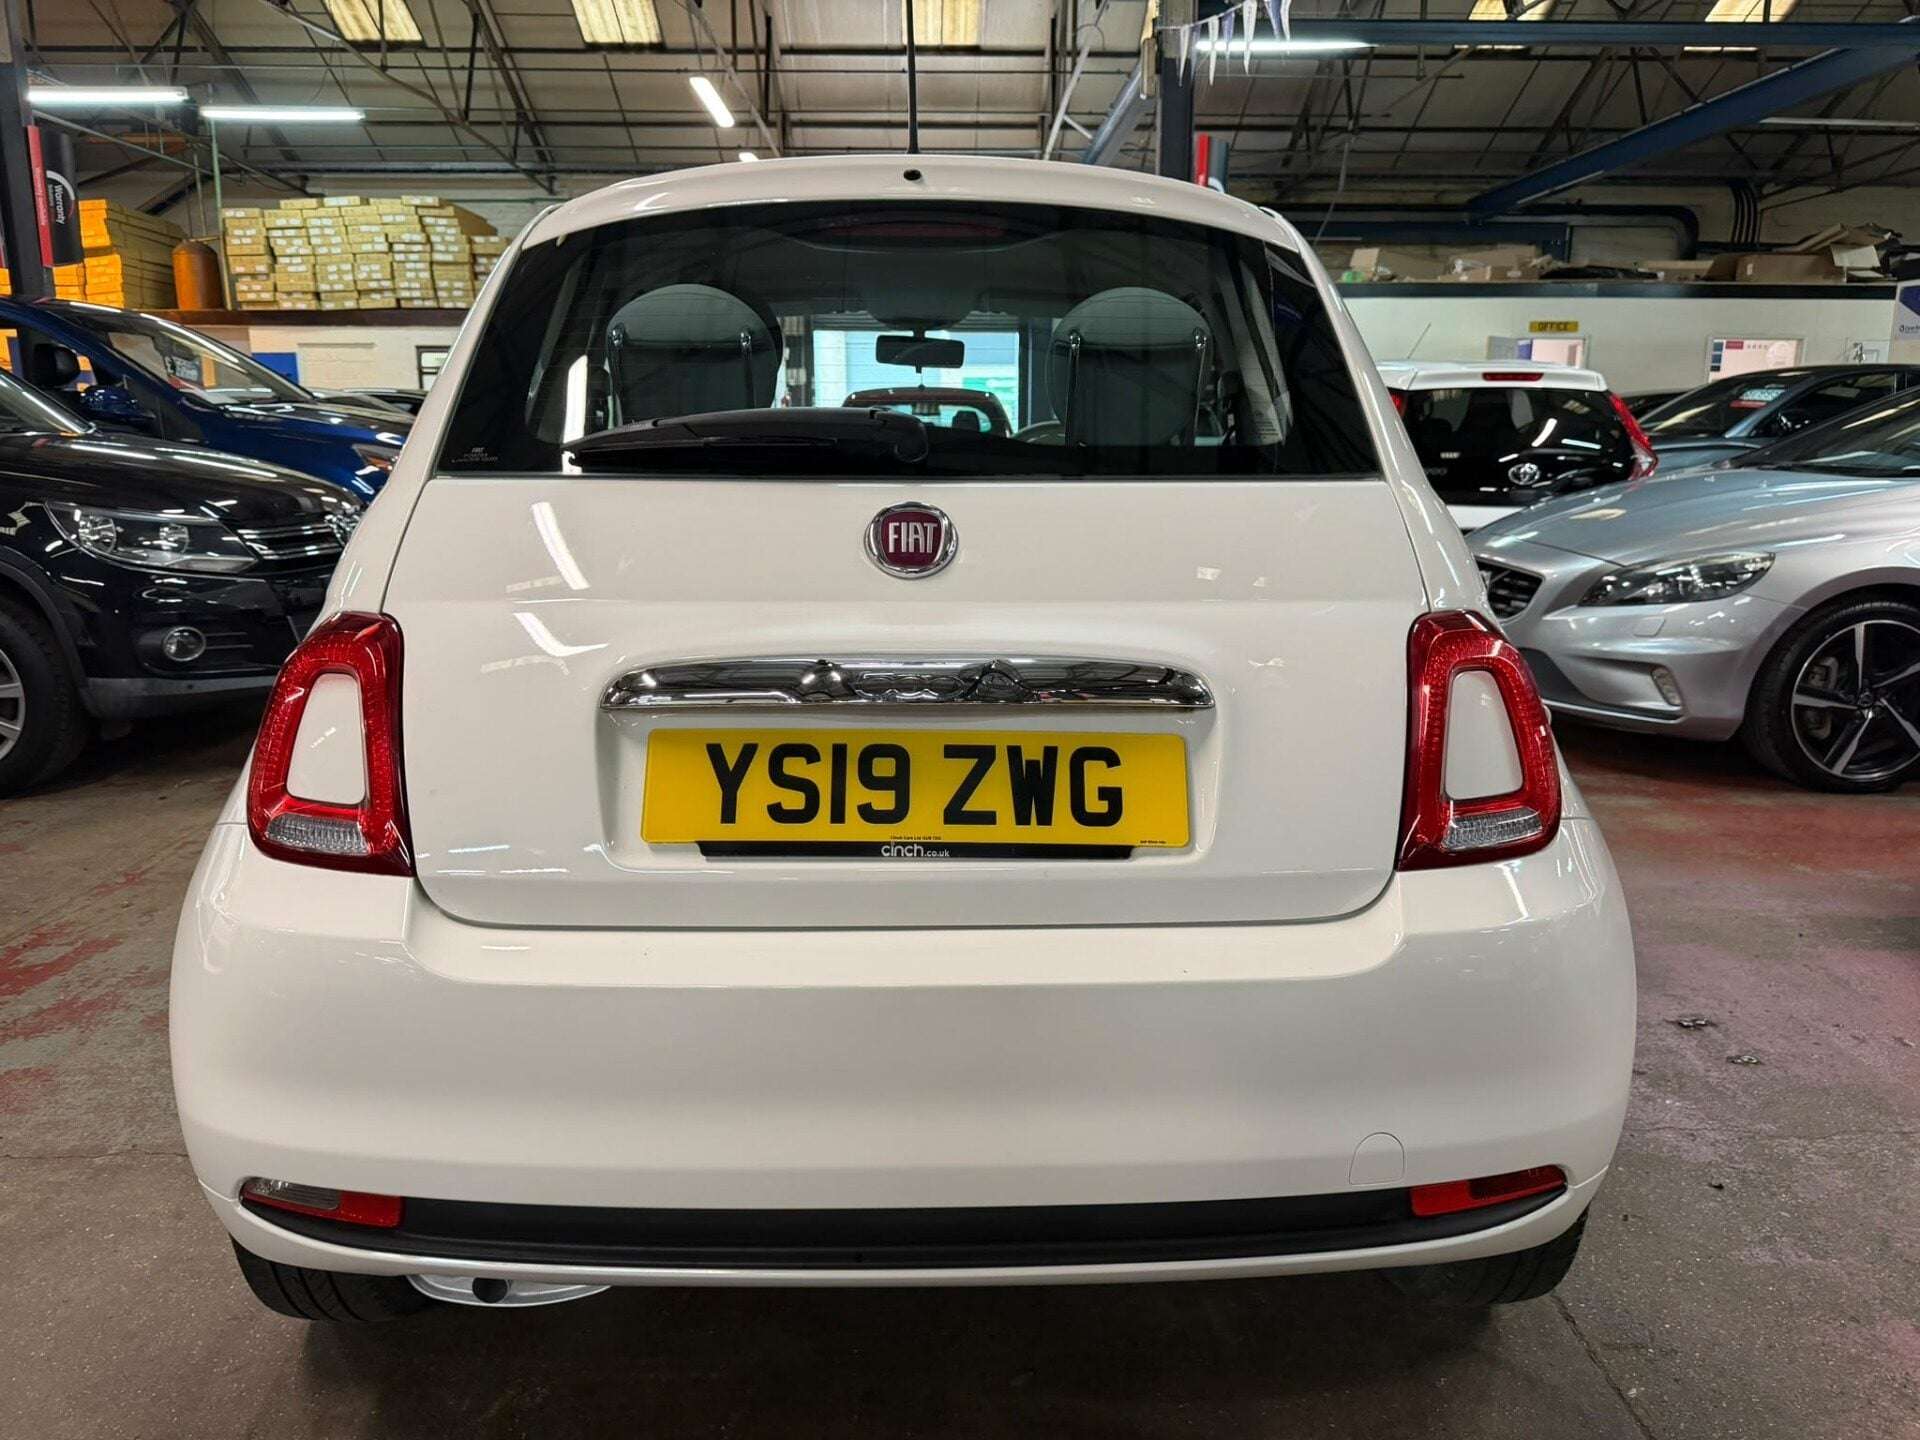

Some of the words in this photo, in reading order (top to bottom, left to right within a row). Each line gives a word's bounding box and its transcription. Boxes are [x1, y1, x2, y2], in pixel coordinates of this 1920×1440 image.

[54, 184, 66, 225] Warranty
[1537, 321, 1569, 332] OFFICE
[888, 522, 938, 553] FIAT
[706, 743, 911, 824] YS19
[943, 744, 1123, 827] ZWG
